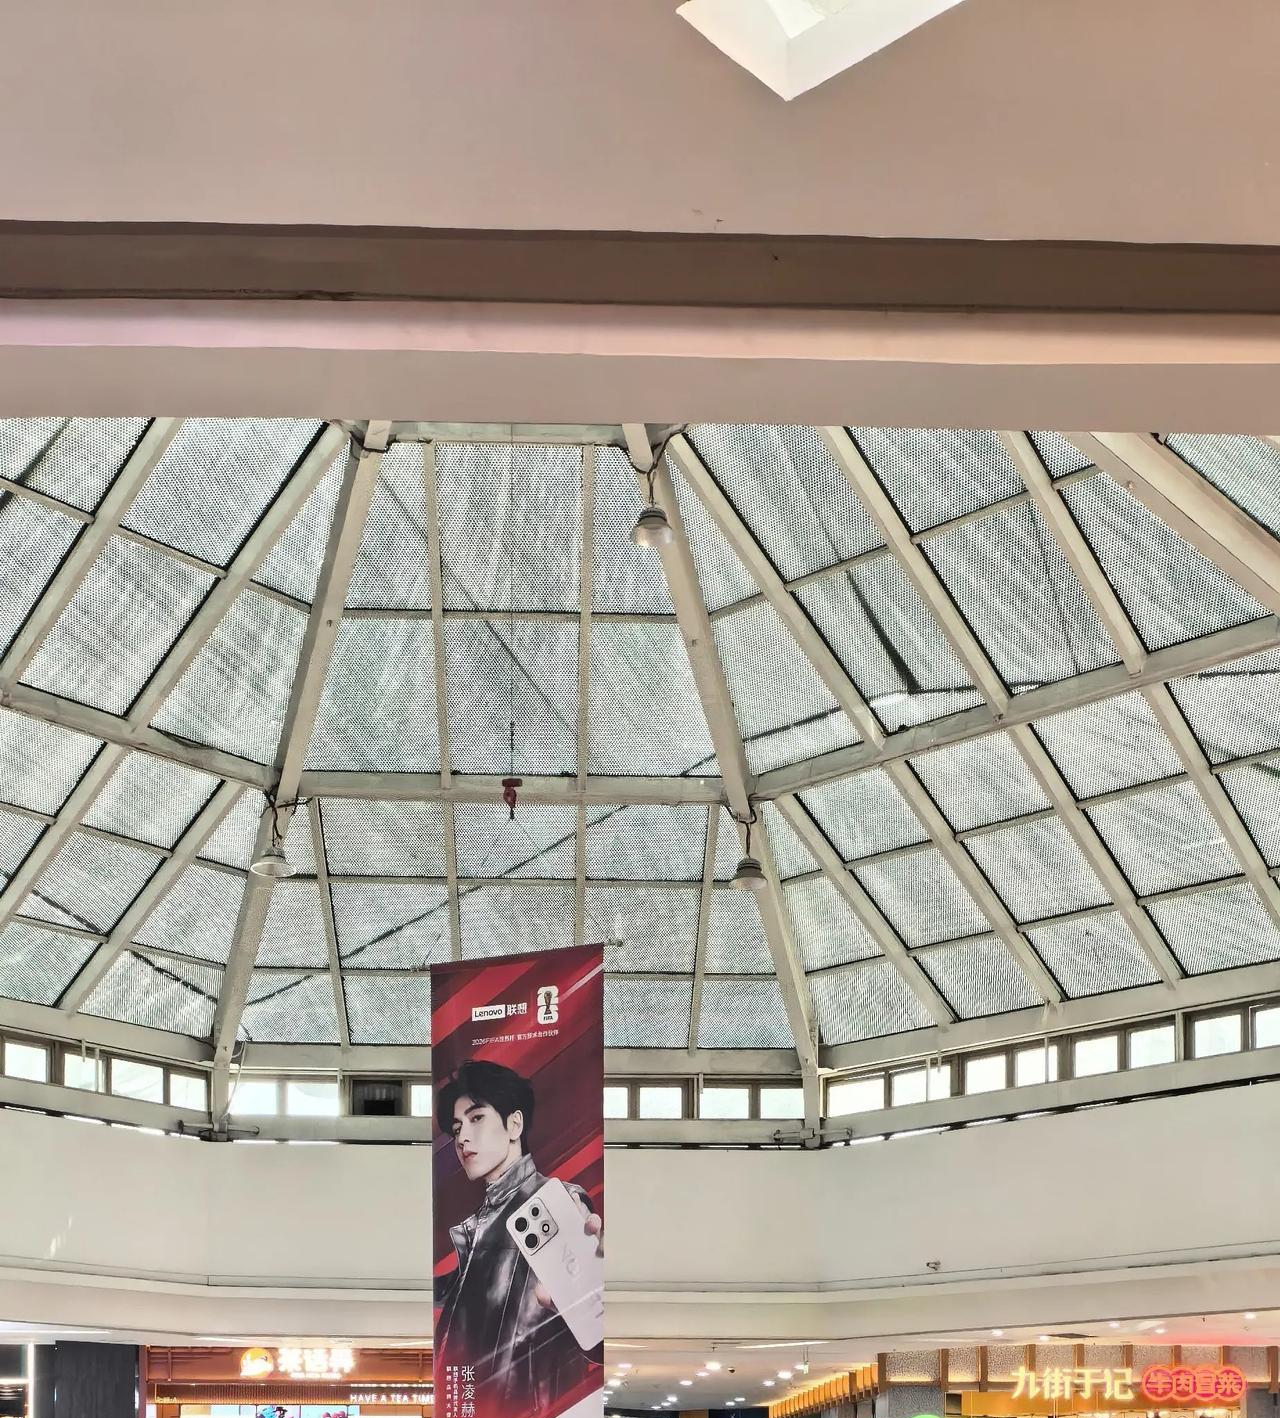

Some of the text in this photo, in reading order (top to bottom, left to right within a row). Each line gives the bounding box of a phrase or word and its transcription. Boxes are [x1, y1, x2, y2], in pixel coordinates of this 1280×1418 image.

[474, 1008, 503, 1018] Lenovo
[507, 1002, 528, 1016] 联想
[1146, 1370, 1243, 1396] 牛肉冒菜
[461, 1365, 476, 1418] 张凌赫
[350, 1394, 434, 1404] HAVE A TEA TIME
